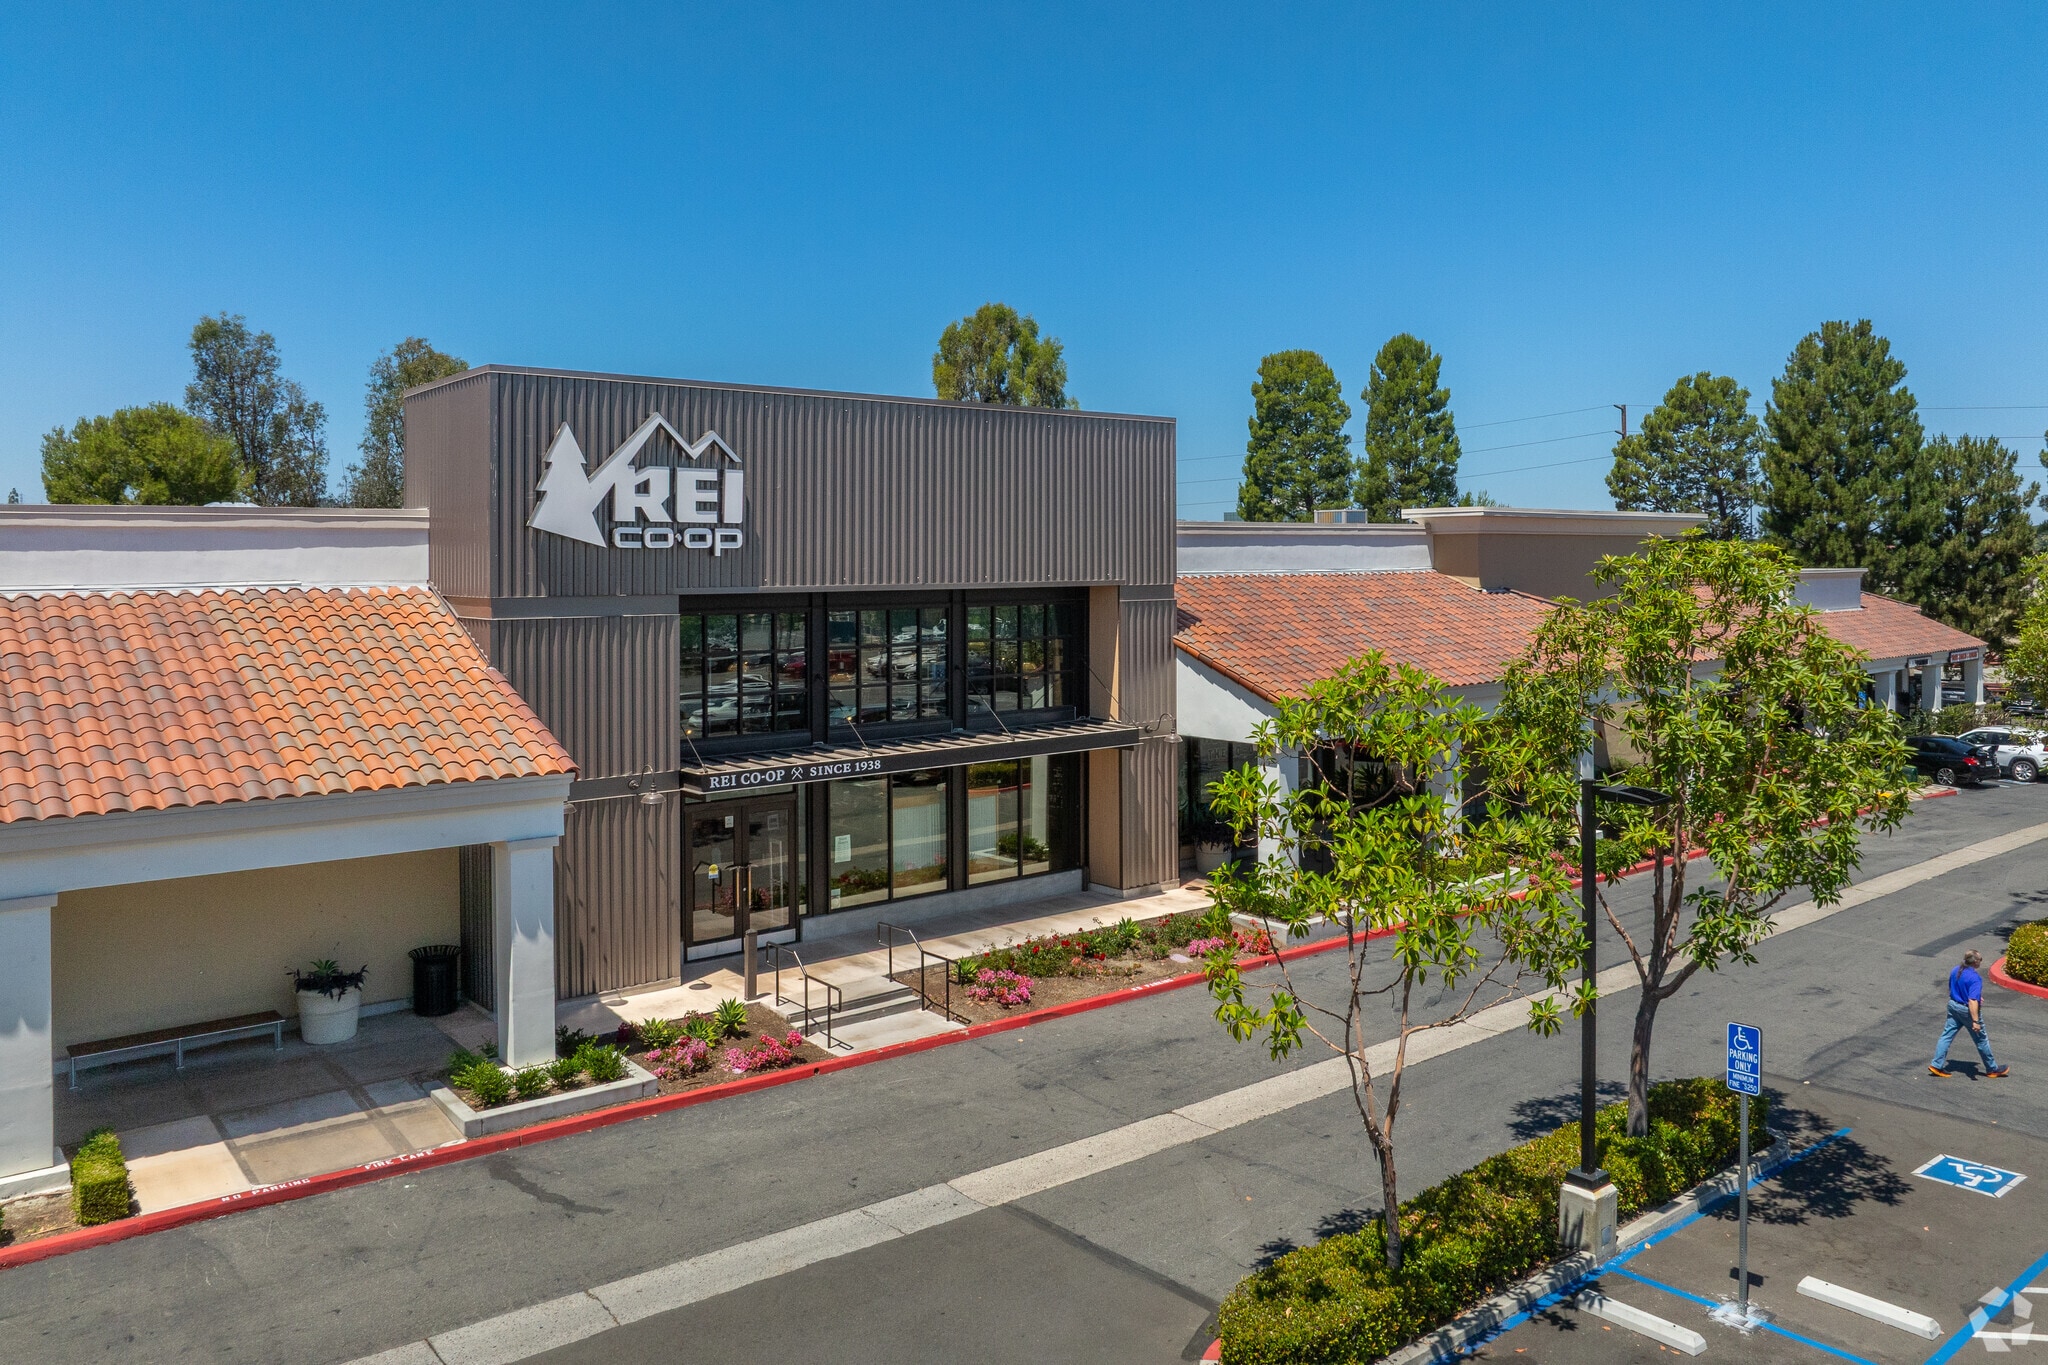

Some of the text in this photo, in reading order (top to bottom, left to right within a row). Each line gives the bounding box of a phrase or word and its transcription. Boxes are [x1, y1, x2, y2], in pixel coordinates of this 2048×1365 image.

[613, 465, 743, 523] REI
[709, 759, 882, 789] REI CO-OP SINCE 1938
[1729, 1048, 1757, 1063] PARKING
[1734, 1059, 1752, 1072] ONLY
[1729, 1079, 1740, 1089] FINE
[1732, 1072, 1754, 1084] MINIMUM
[221, 1149, 434, 1202] NO PARKING FIRE LANE
